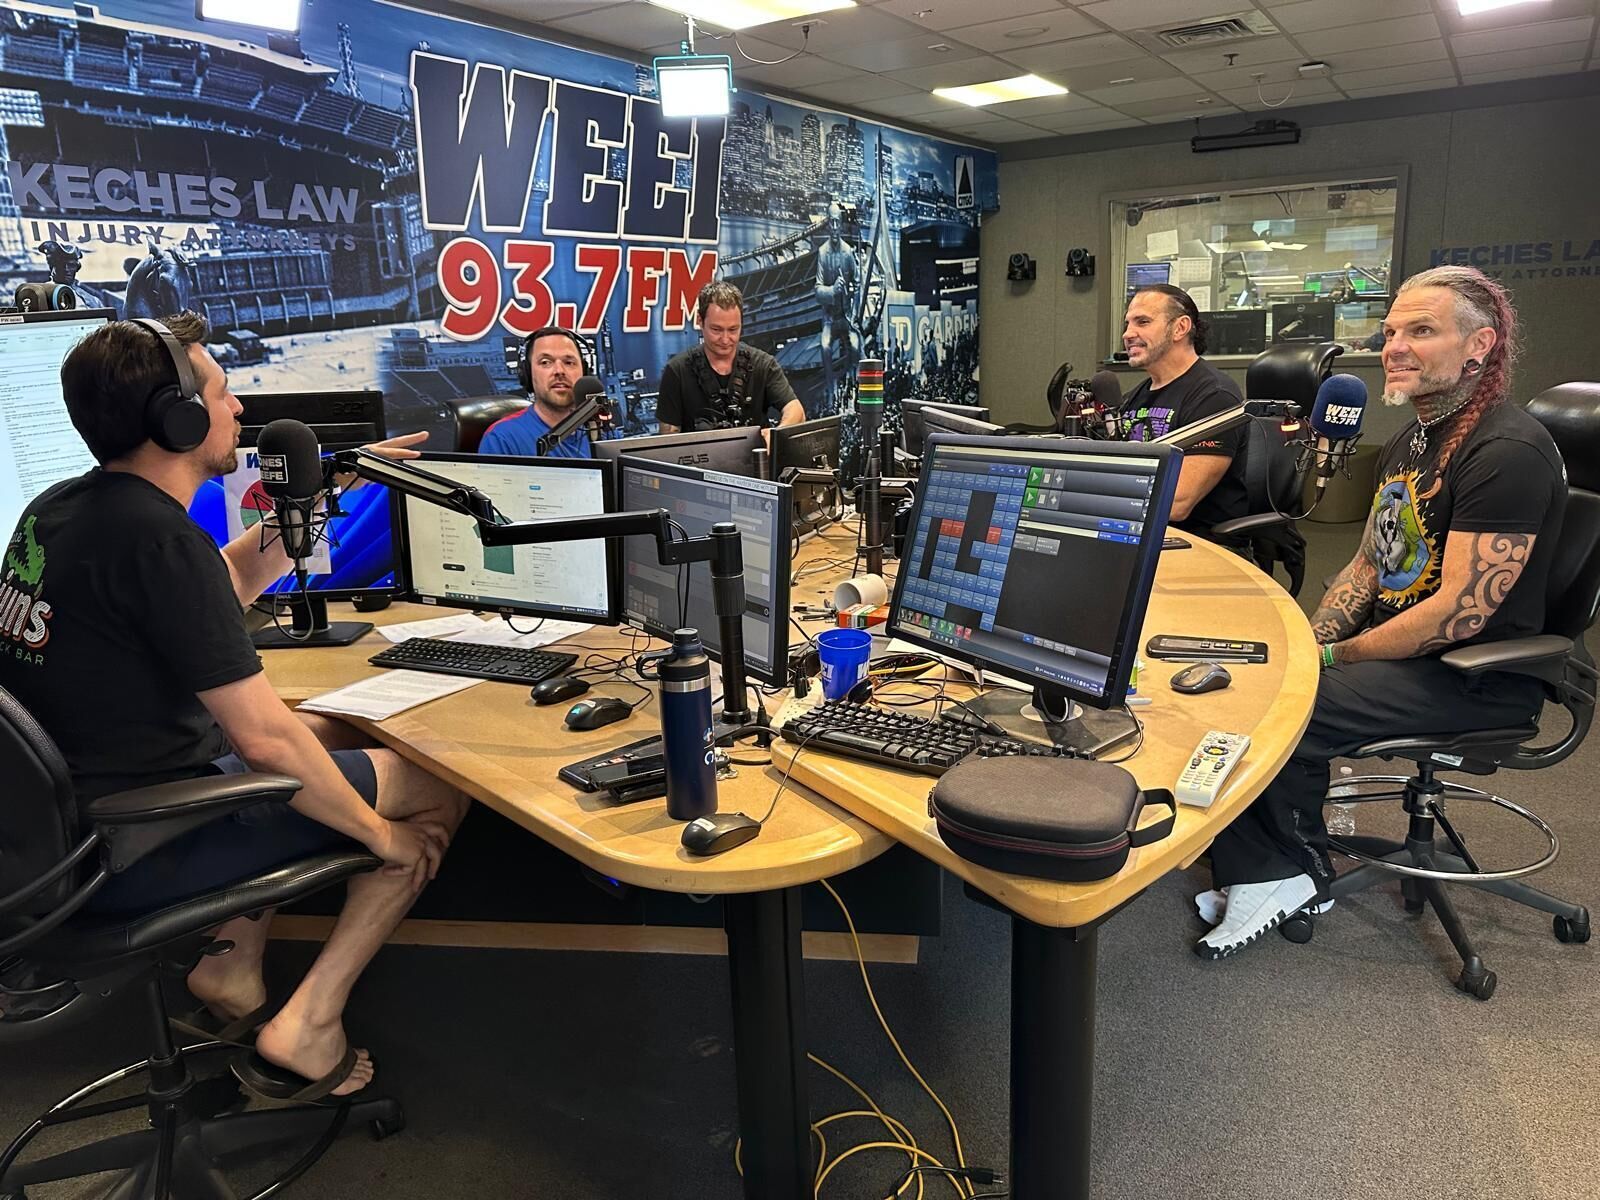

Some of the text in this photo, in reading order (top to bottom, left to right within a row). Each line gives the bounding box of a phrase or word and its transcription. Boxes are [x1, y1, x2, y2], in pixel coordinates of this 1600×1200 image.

[409, 50, 728, 246] WEEI
[7, 160, 359, 224] KECHES LAW
[32, 221, 356, 252] INJURY ATTORNEYS
[1430, 242, 1553, 268] KECHES
[890, 313, 978, 352] TD GARDEN
[1326, 403, 1362, 419] WEEI
[678, 454, 709, 465] ASUS
[16, 648, 44, 666] BAR
